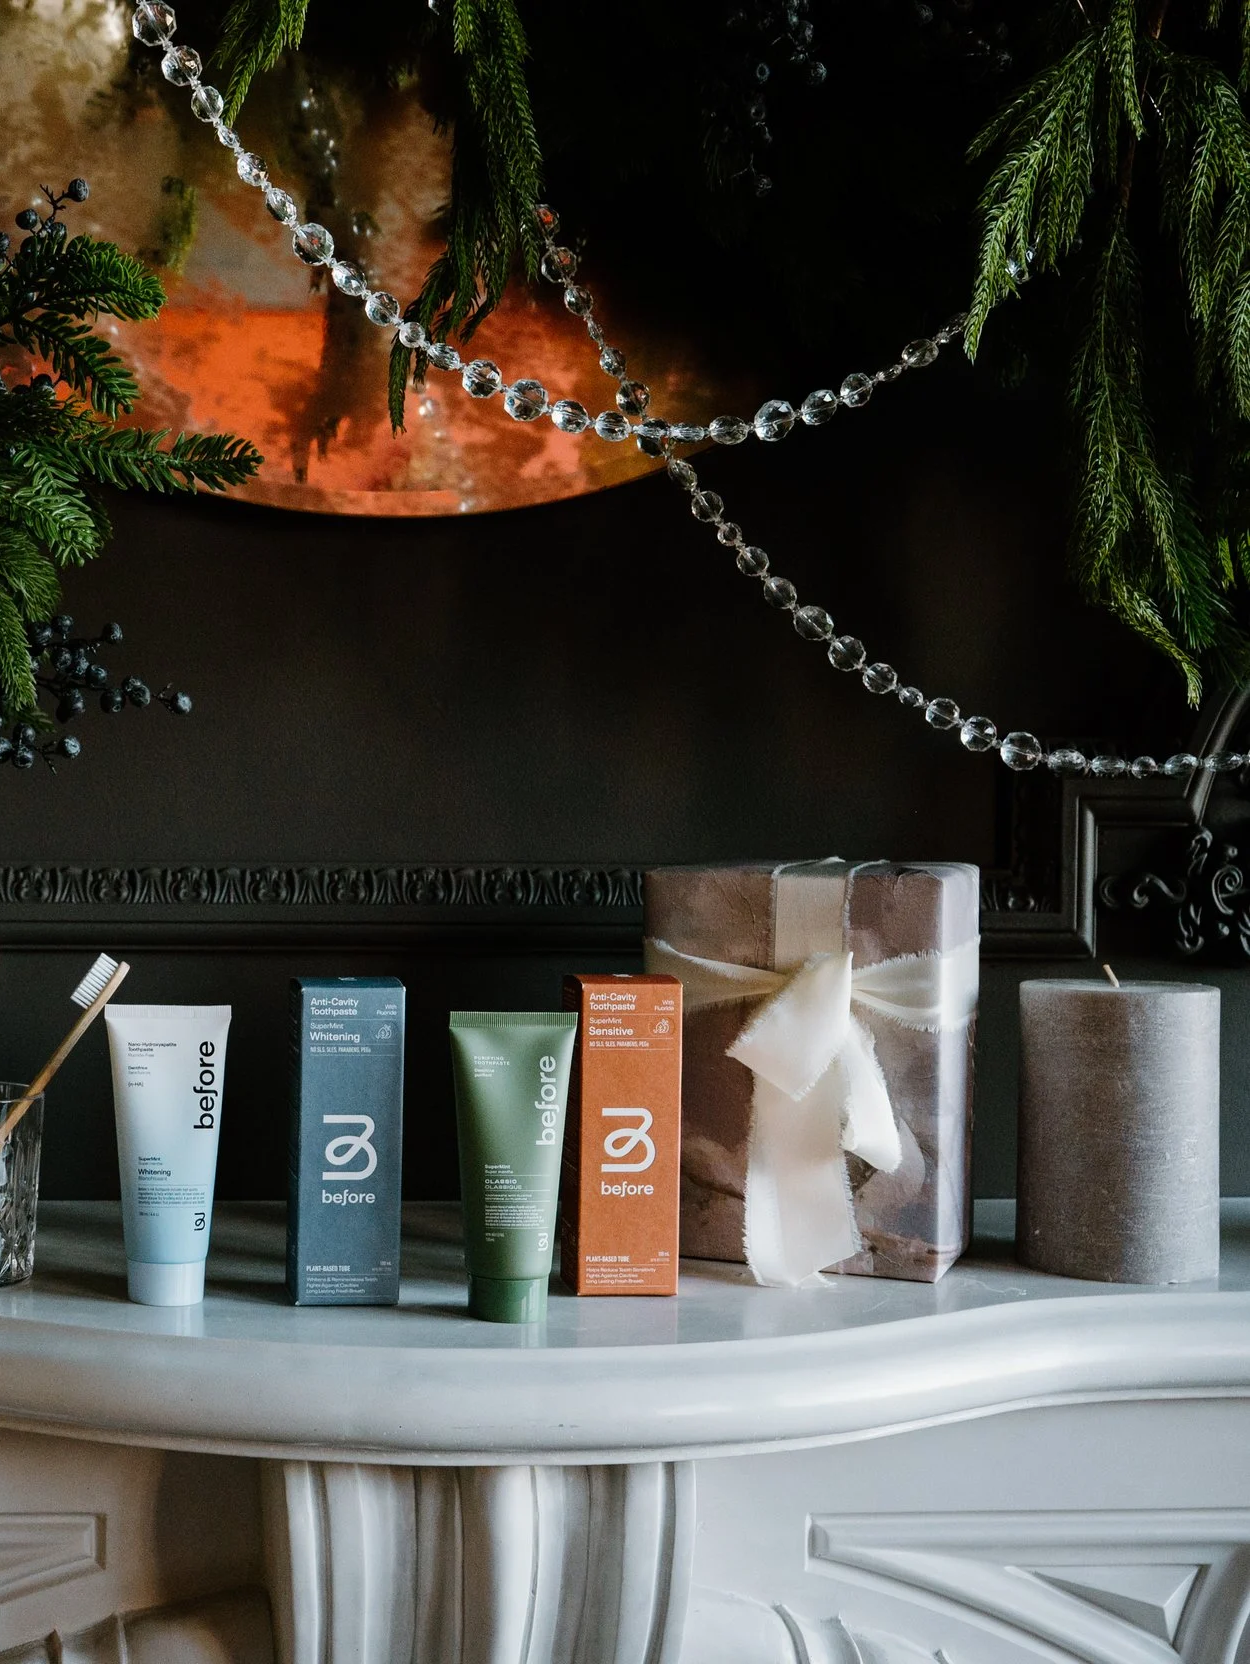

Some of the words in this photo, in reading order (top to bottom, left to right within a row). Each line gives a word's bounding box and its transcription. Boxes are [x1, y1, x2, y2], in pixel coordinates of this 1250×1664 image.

[310, 997, 359, 1007] Anti-Cavity
[589, 993, 636, 1002] Anti-Cavity
[310, 1007, 358, 1017] Toothpaste
[590, 1002, 636, 1012] Toothpaste
[310, 1022, 344, 1030] SuperMint
[589, 1017, 622, 1025] SuperMint
[589, 1026, 634, 1036] Sensitive
[310, 1031, 360, 1043] Whitening
[193, 1041, 218, 1129] before
[534, 1055, 560, 1146] before
[138, 1168, 171, 1176] Whitening
[601, 1181, 654, 1197] before
[322, 1189, 376, 1206] before
